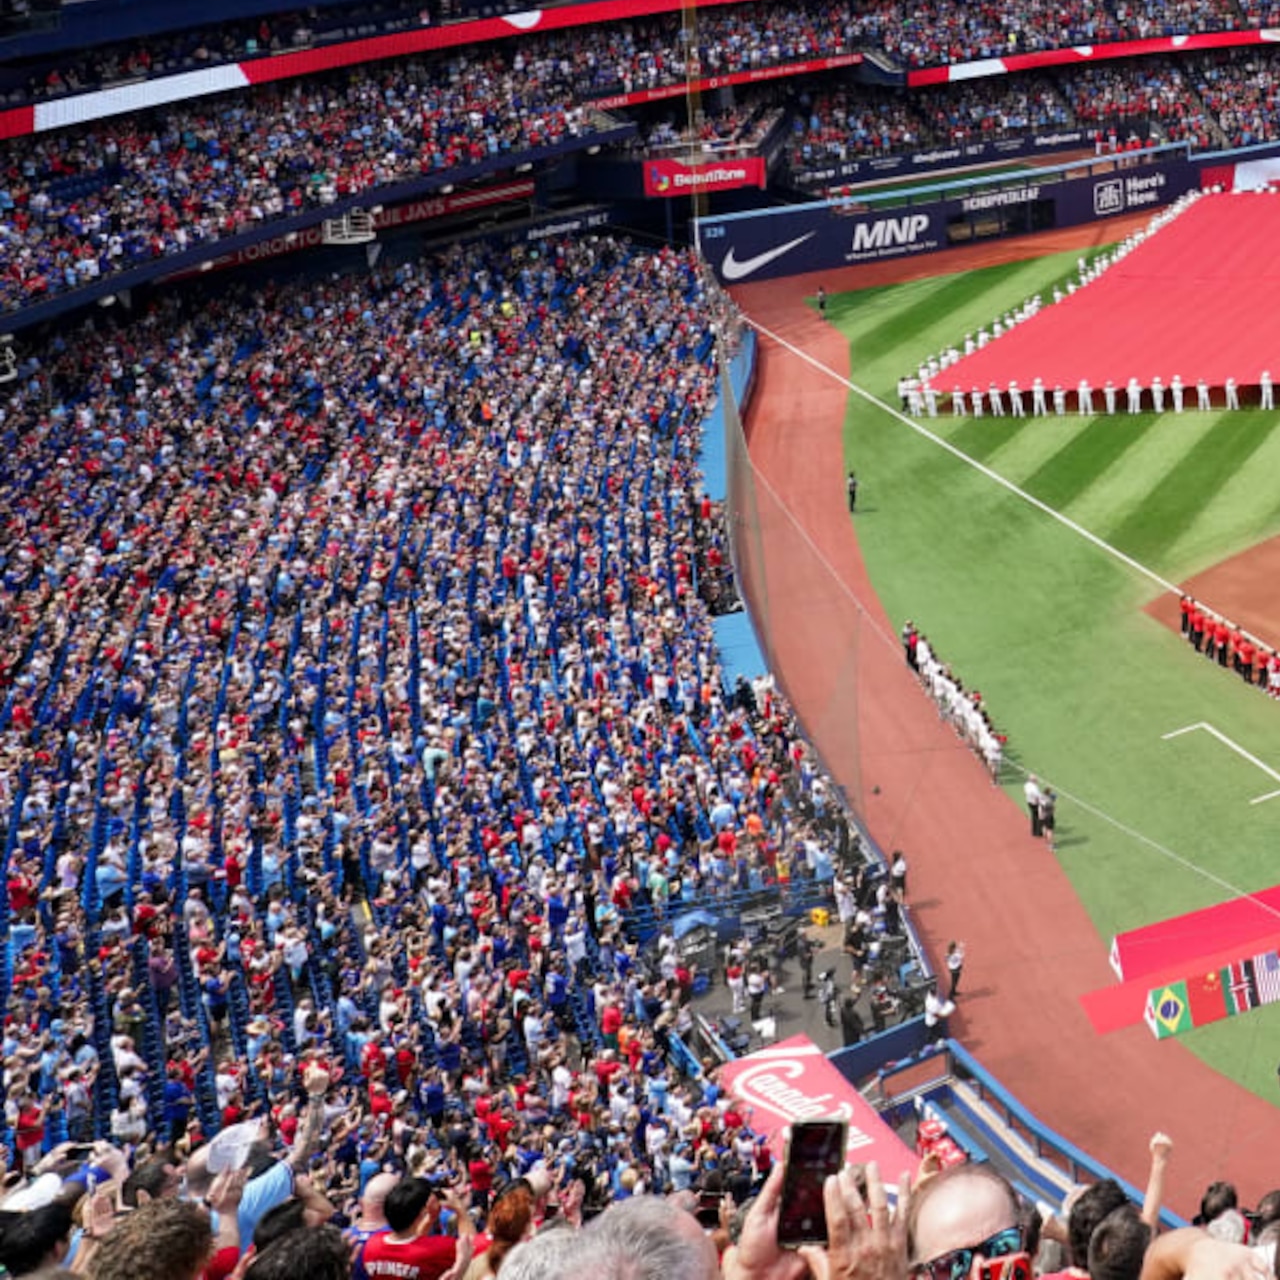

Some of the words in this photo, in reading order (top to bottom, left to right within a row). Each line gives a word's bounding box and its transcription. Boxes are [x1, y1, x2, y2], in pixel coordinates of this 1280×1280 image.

[404, 199, 445, 221] JAYS
[851, 213, 930, 251] MNP
[364, 1260, 421, 1280] PRINGER
